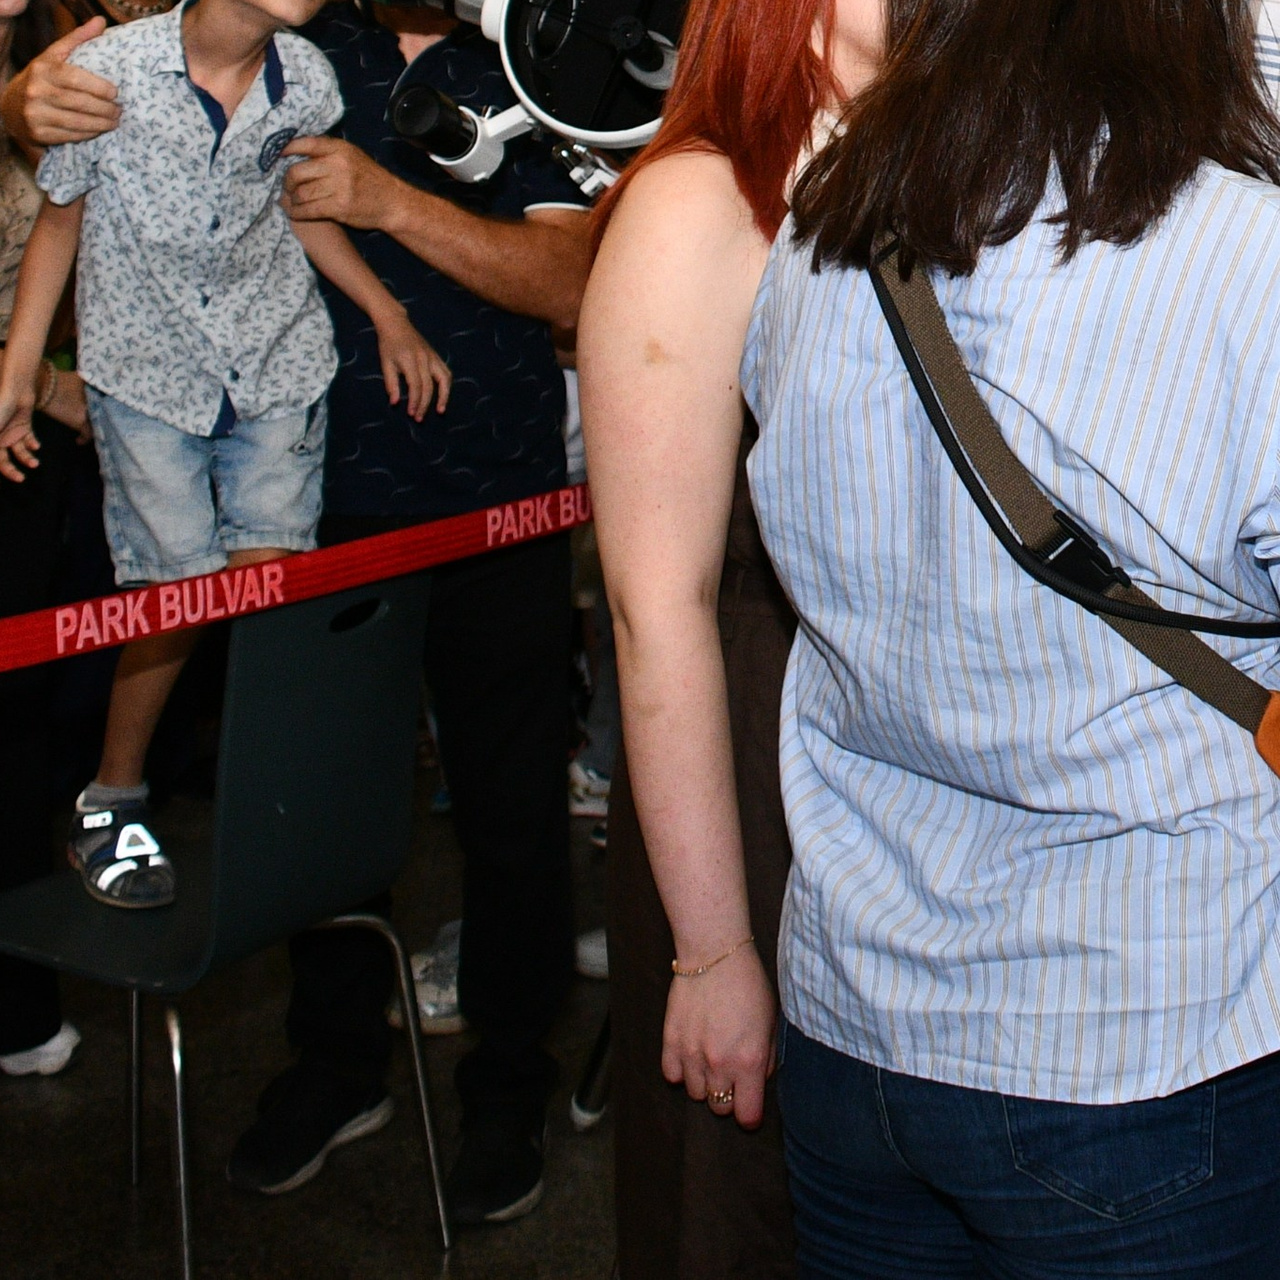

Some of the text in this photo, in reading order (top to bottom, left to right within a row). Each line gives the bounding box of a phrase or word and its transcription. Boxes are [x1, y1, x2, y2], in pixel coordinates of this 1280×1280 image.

[486, 494, 553, 547] PARK
[55, 563, 285, 654] PARK BULVAR
